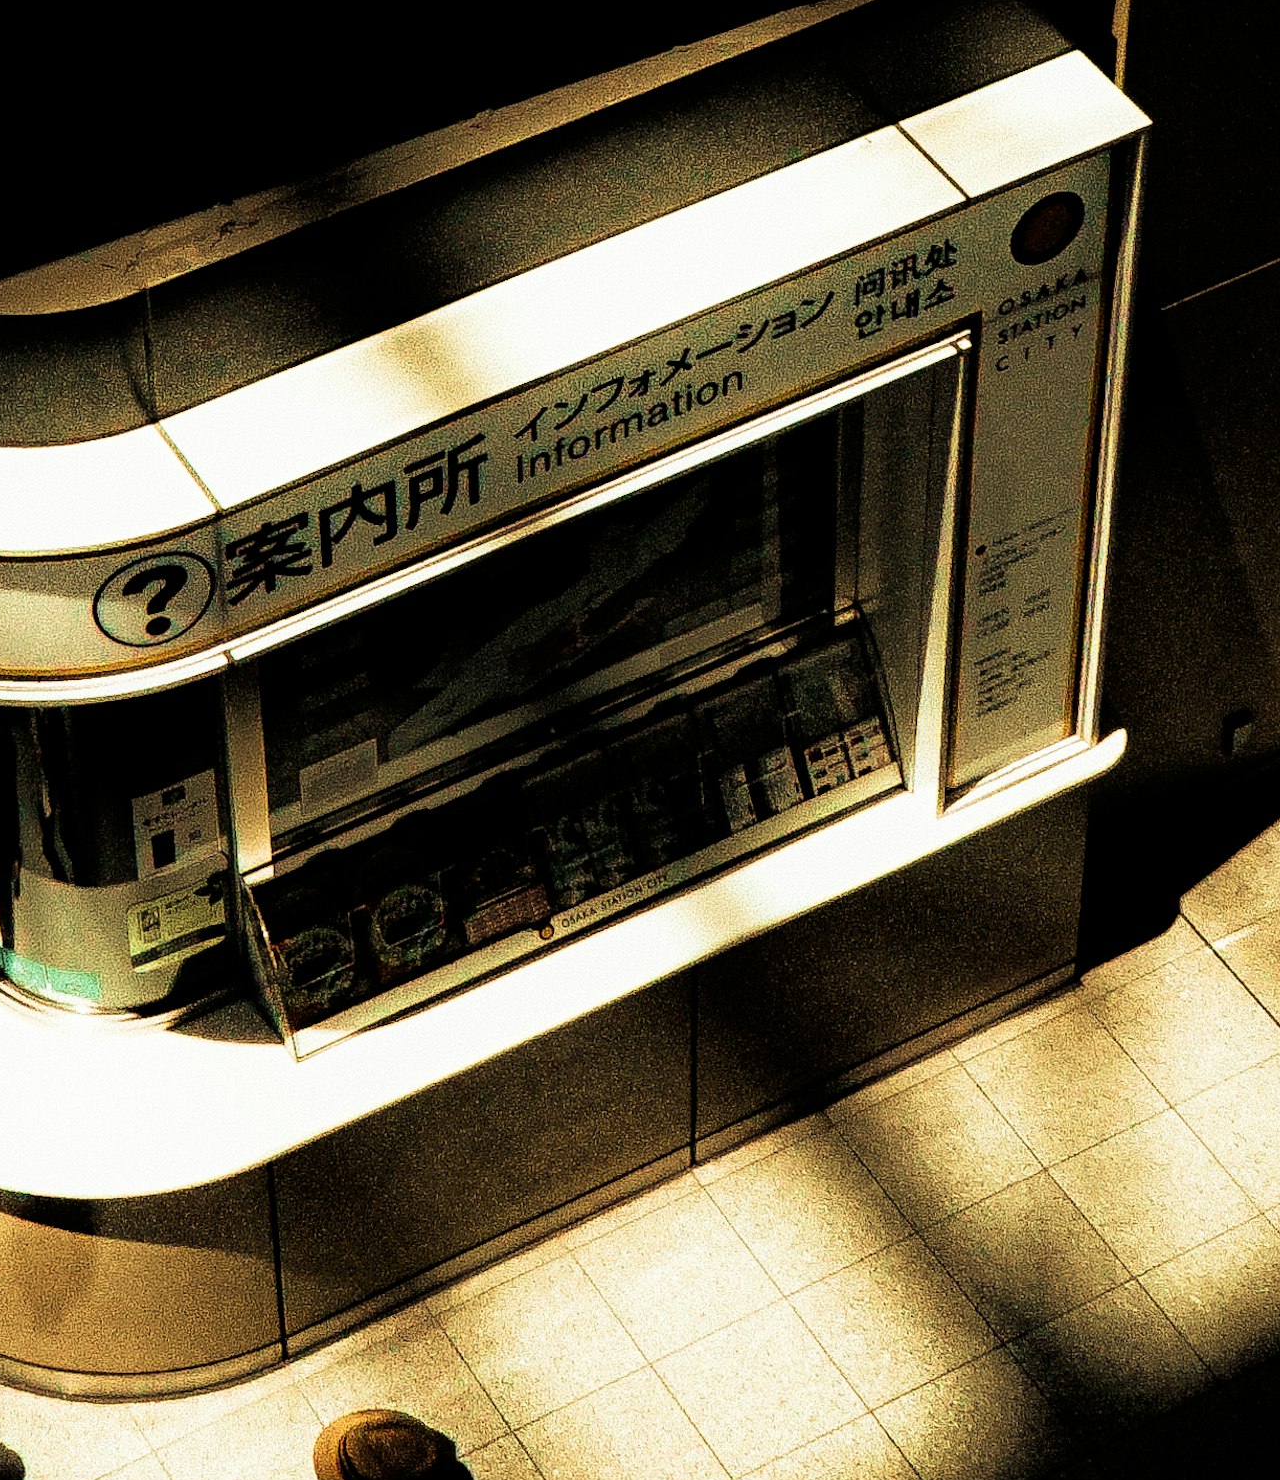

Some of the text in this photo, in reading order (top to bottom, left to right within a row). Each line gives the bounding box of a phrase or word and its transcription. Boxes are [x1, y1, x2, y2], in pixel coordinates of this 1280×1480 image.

[853, 238, 959, 306] 问讯处
[997, 269, 1089, 316] OSAKA
[853, 278, 957, 340] 안내소
[997, 295, 1087, 345] STATION
[513, 291, 837, 442] インフォメーション
[516, 369, 745, 485] Information
[224, 432, 489, 607] 案内所
